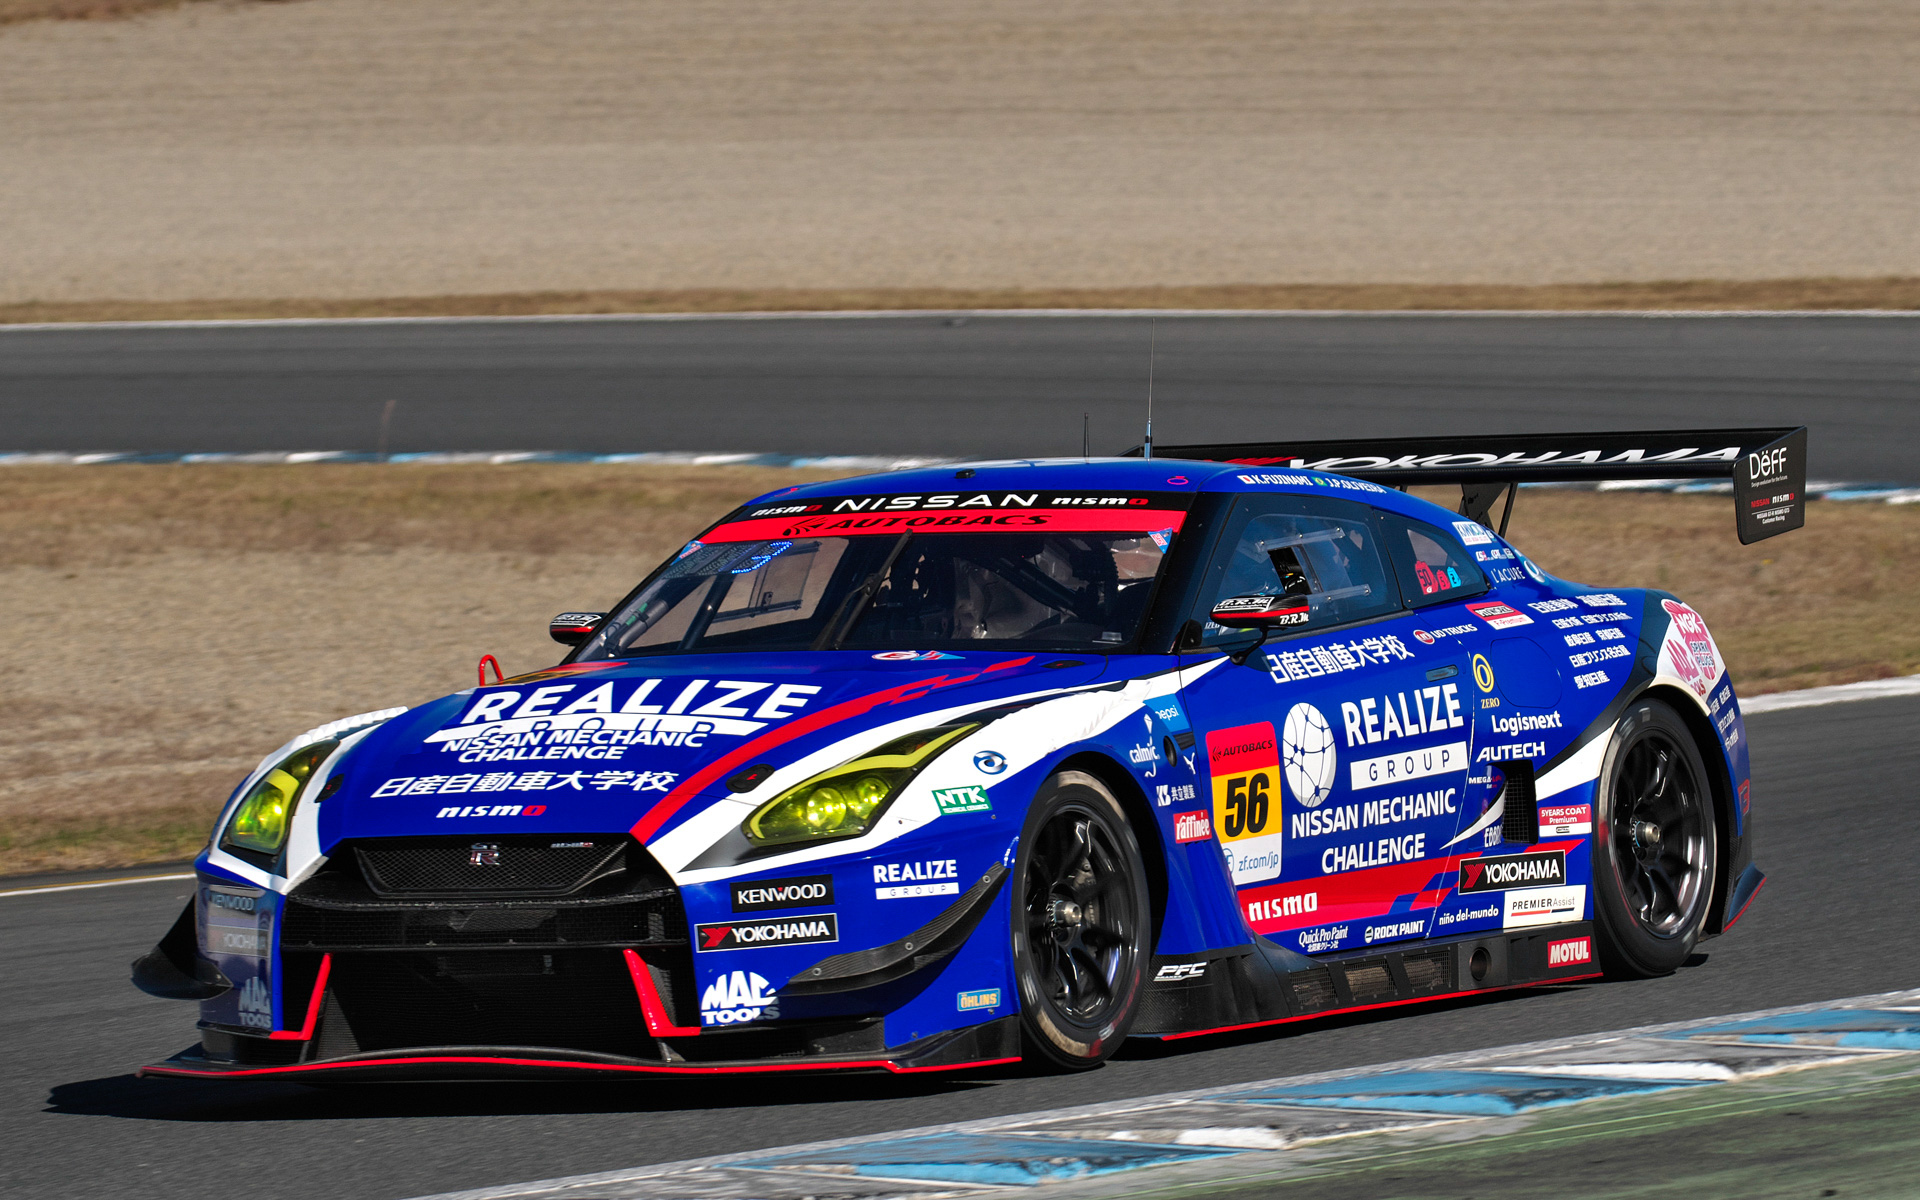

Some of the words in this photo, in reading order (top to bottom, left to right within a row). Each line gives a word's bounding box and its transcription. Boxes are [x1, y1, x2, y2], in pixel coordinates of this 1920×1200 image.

[1290, 446, 1741, 471] YOKOHAMA
[832, 493, 1039, 512] NISSAN
[1051, 496, 1150, 506] nismo
[1750, 498, 1770, 508] NISSAN
[824, 514, 1053, 530] AUTOBACS
[1430, 629, 1447, 638] UD
[1442, 624, 1478, 636] TRUCKS
[1675, 612, 1703, 634] NGK
[1266, 634, 1416, 684] 日産自動車大学校
[460, 678, 823, 724] REALIZE
[1480, 697, 1501, 710] ZERO
[1340, 682, 1465, 748] REALIZE
[1492, 710, 1563, 737] Logisnext
[440, 730, 545, 753] NISSAN
[544, 728, 708, 748] MECHANIC
[1222, 739, 1274, 757] AUTOBACS
[1476, 740, 1546, 763] AUTECH
[458, 746, 628, 764] CHALLENGE
[1368, 749, 1451, 782] GROUP
[370, 770, 680, 799] 日産自動車大学校
[934, 787, 986, 808] NTK
[1224, 772, 1270, 838] 56
[436, 804, 548, 819] nismo
[1291, 804, 1358, 840] NISSAN
[1362, 787, 1457, 828] MECHANIC
[1542, 808, 1565, 818] 5YEARS
[1565, 806, 1587, 816] COAT
[1549, 816, 1578, 825] Premium
[1238, 850, 1280, 872] zf.com/jp
[1321, 832, 1426, 875] CHALLENGE
[873, 859, 958, 884] REALIZE
[1485, 858, 1561, 884] YOKOHAMA
[737, 884, 827, 905] KENWOOD
[890, 884, 948, 897] GROUP
[1456, 904, 1499, 922] del-mundo
[730, 921, 831, 944] YOKOHAMA
[1298, 928, 1320, 948] Quick
[1320, 928, 1332, 942] Pro
[1331, 924, 1349, 940] Paint
[1374, 922, 1398, 940] ROCK
[1399, 920, 1426, 936] PAINT
[1550, 940, 1589, 965] MOTUL
[1156, 962, 1208, 976] PFC
[701, 970, 780, 1011] MAC
[960, 992, 998, 1008] ÖHLINS
[701, 1006, 781, 1025] TOOLS
